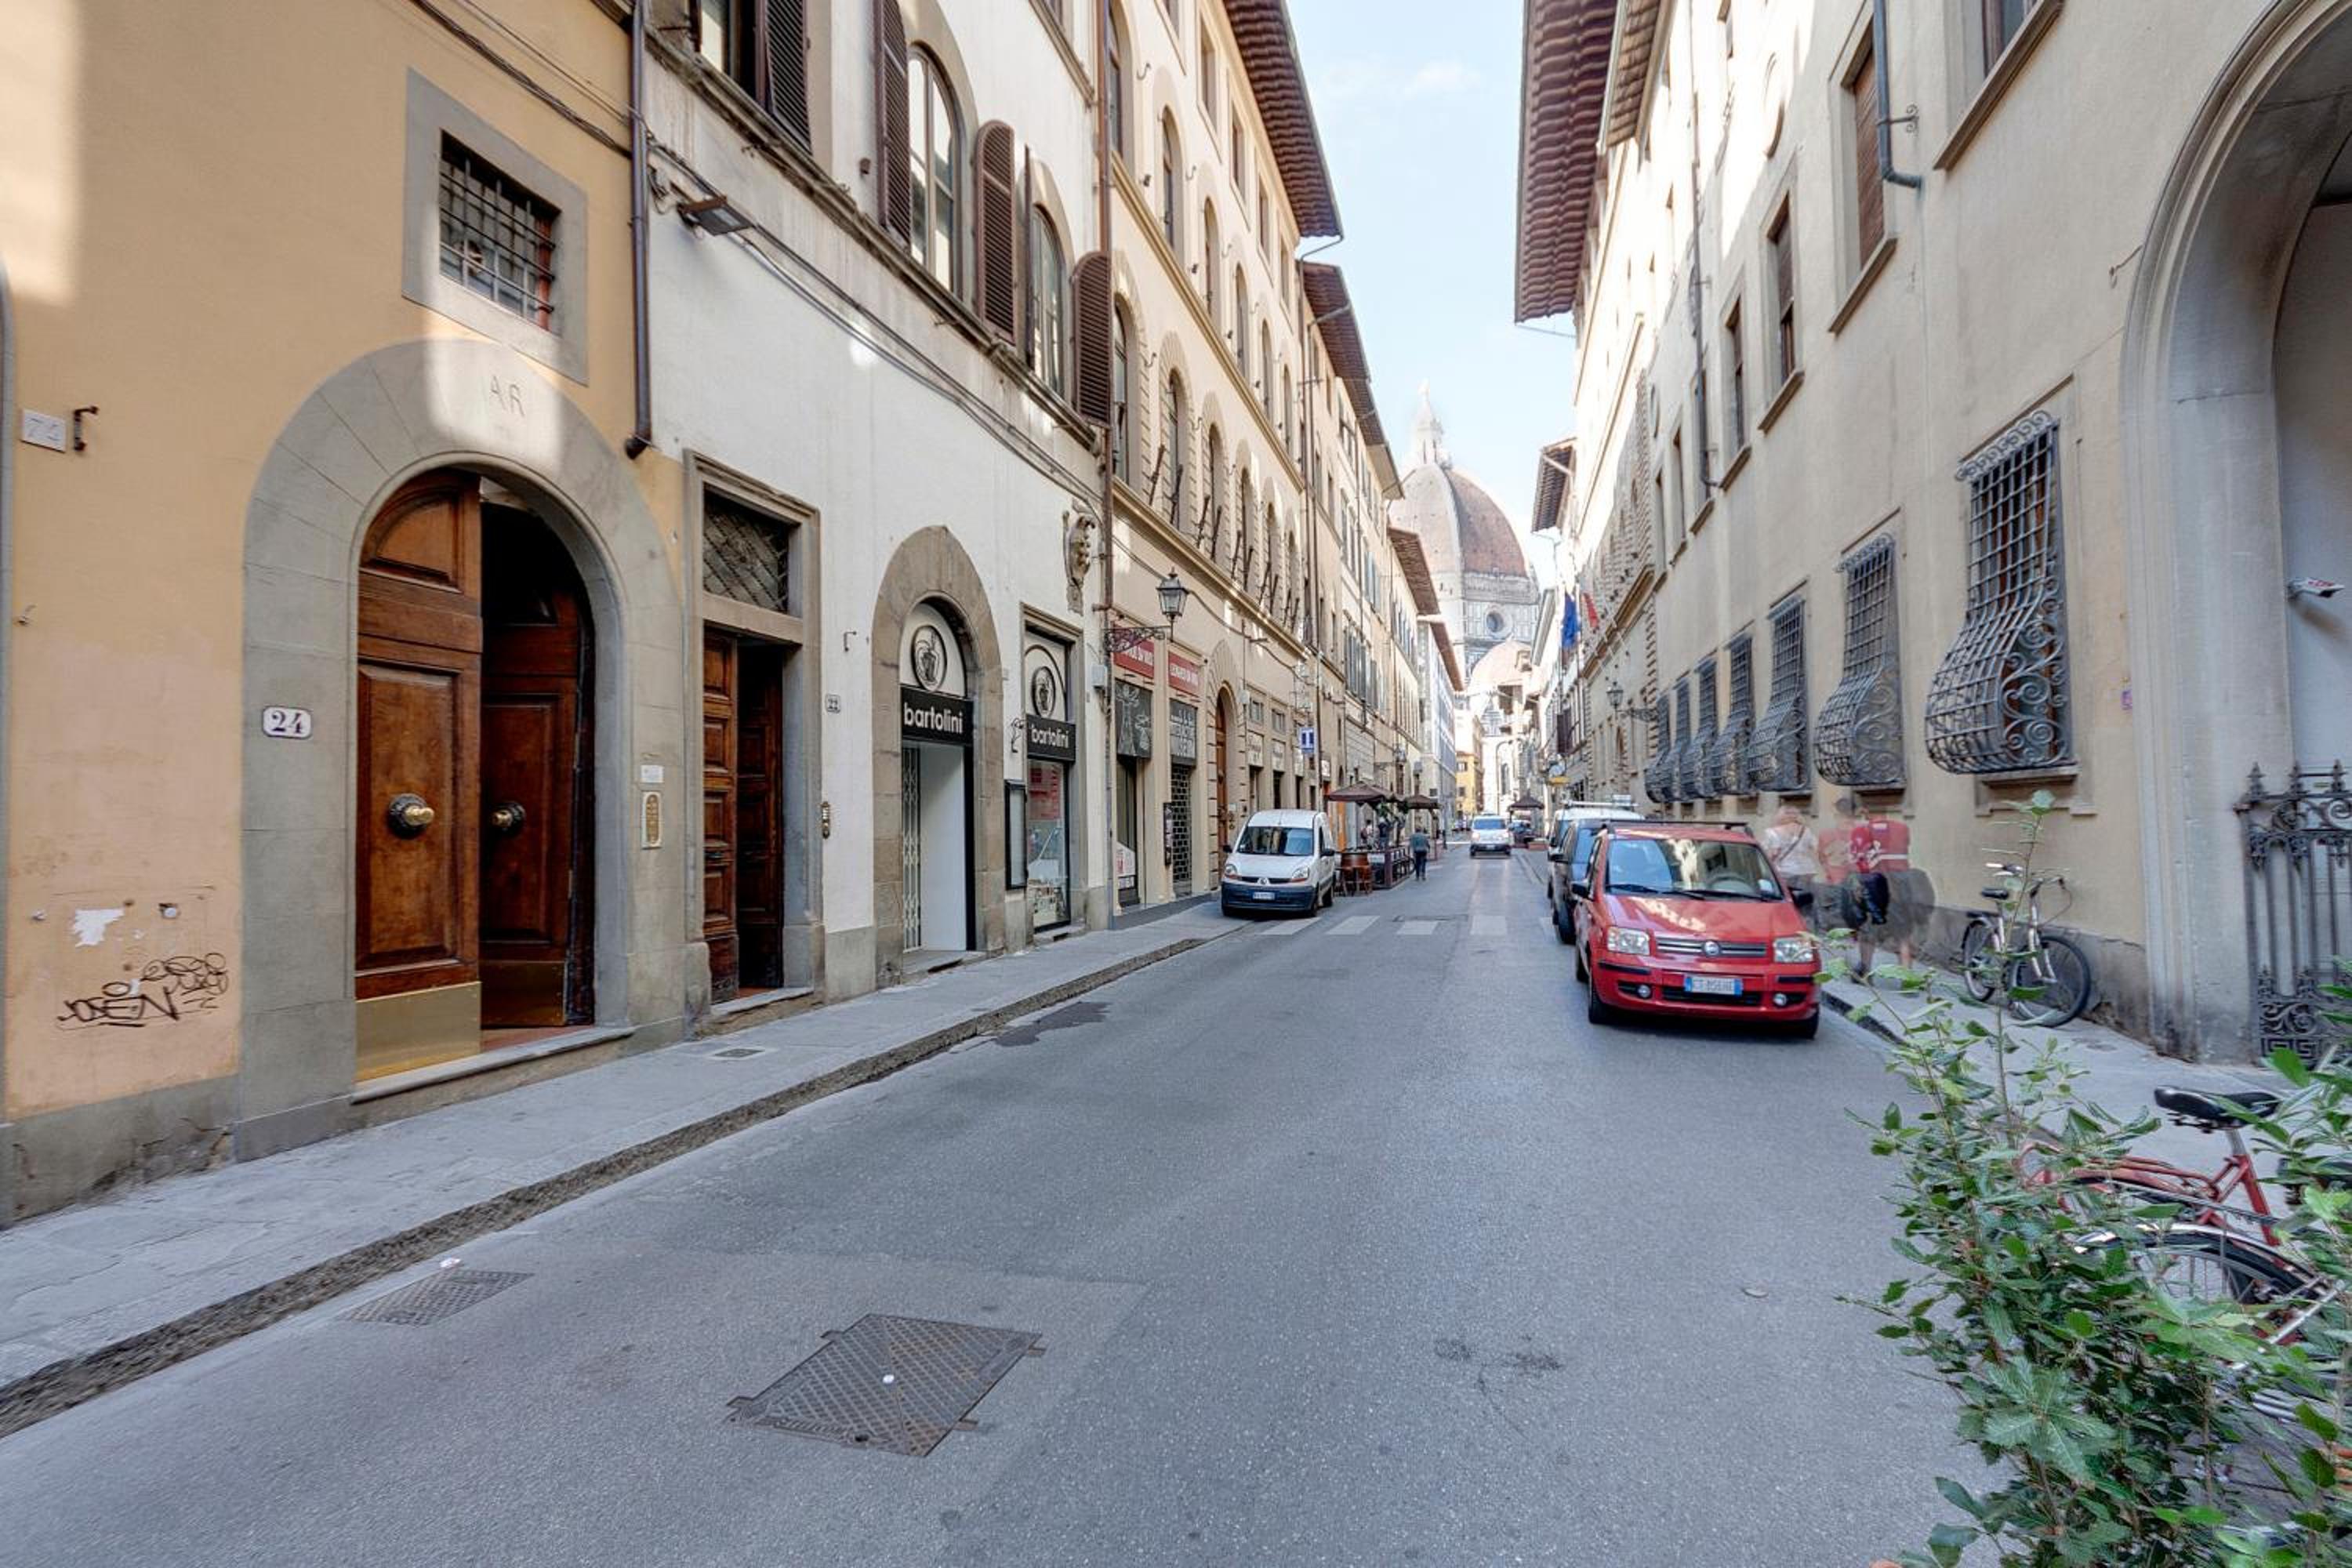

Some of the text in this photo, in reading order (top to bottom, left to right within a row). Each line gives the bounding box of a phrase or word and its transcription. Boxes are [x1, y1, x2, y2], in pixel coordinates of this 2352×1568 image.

[271, 710, 304, 734] 24
[904, 702, 963, 735] bartolini
[1031, 724, 1069, 749] bartolini
